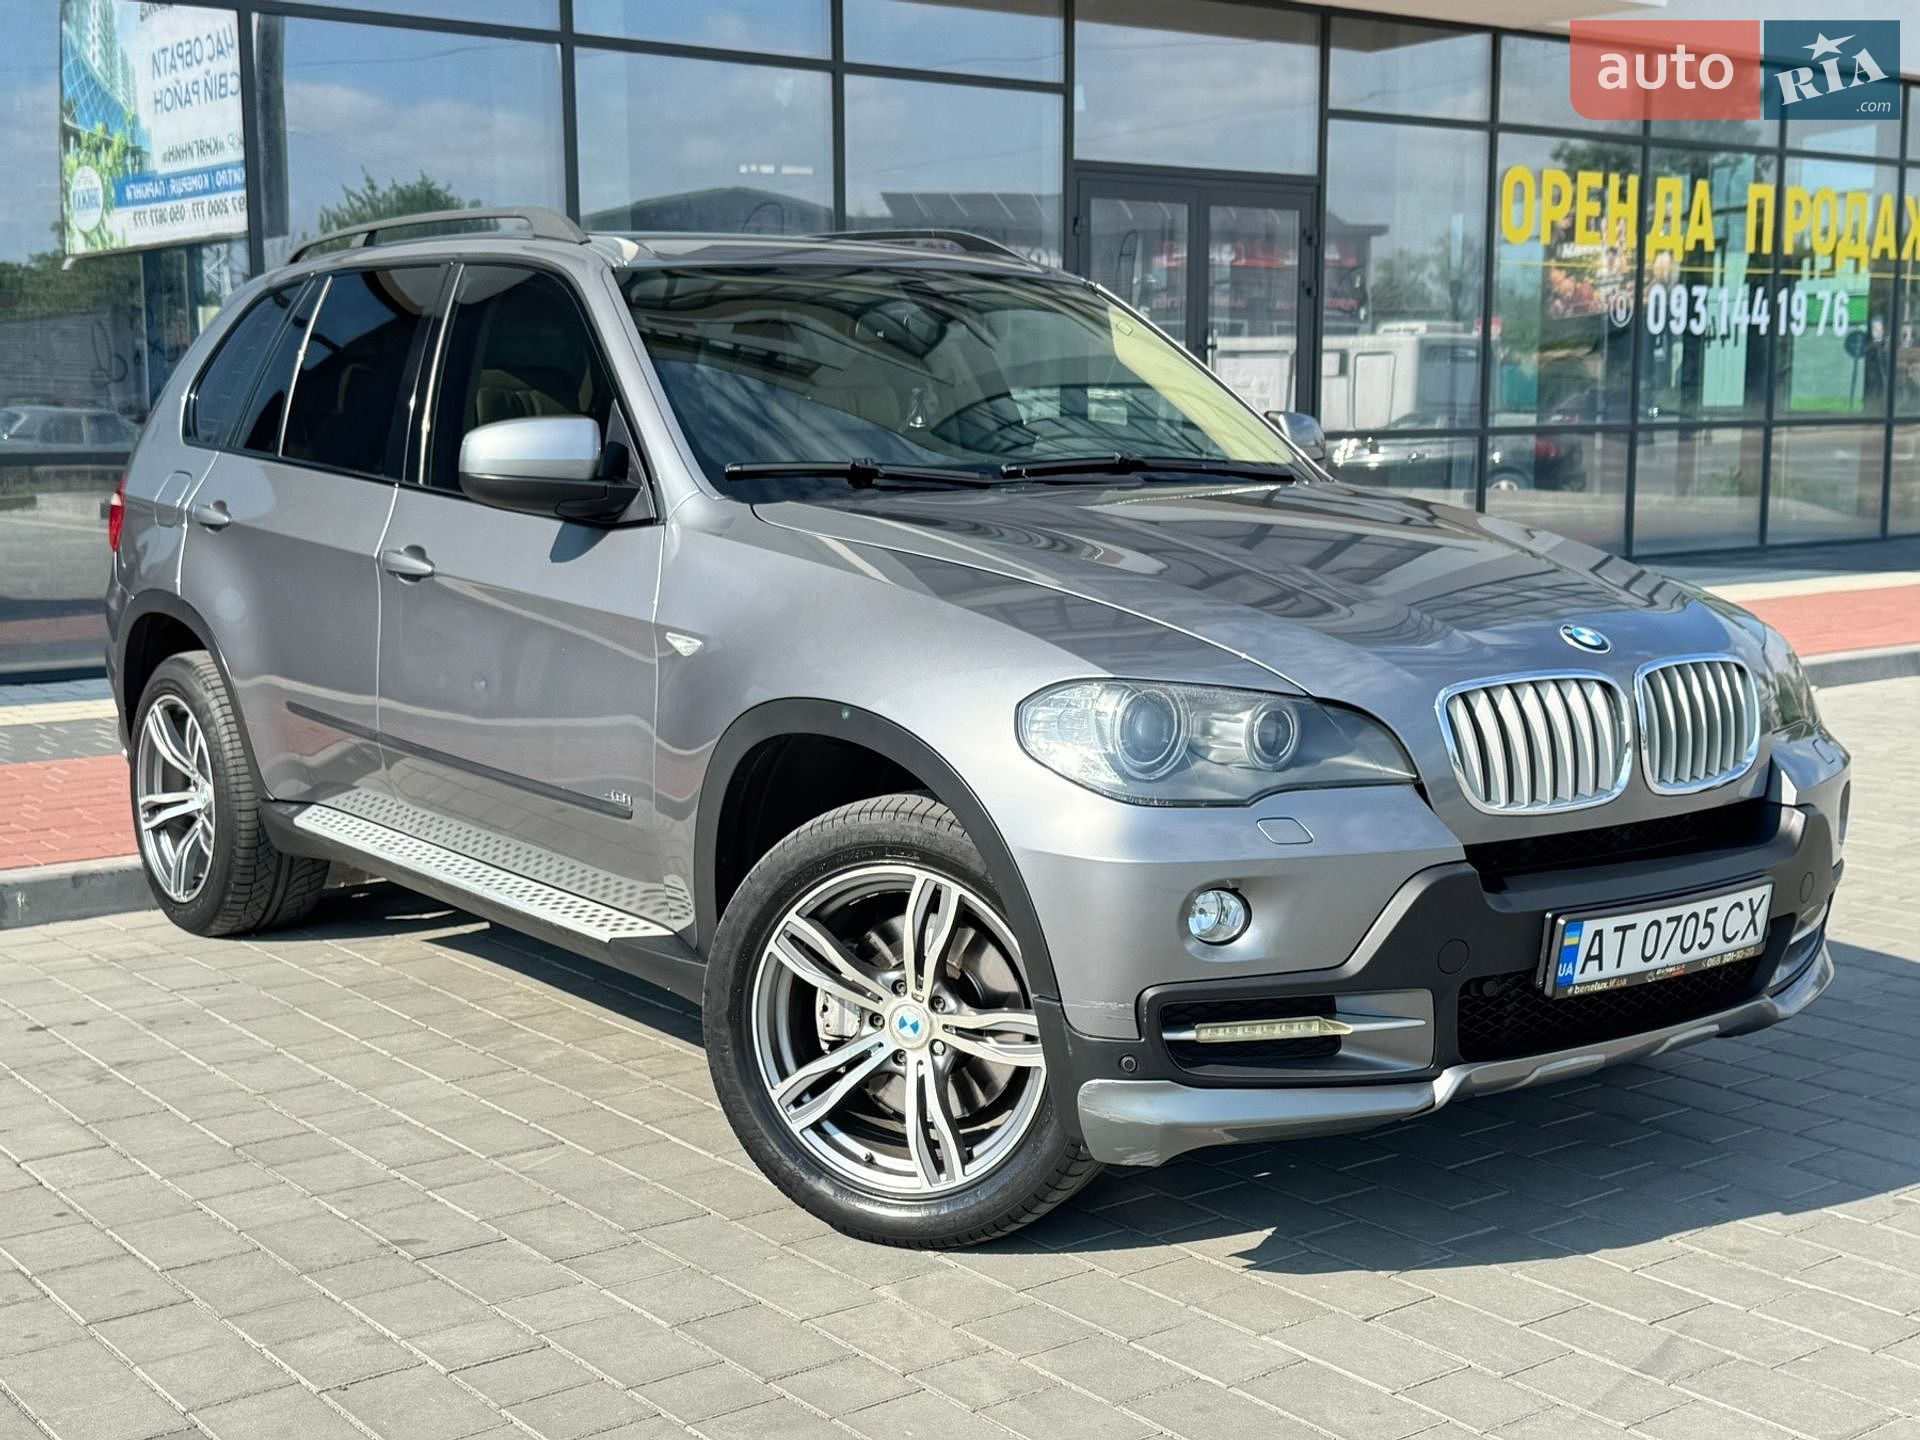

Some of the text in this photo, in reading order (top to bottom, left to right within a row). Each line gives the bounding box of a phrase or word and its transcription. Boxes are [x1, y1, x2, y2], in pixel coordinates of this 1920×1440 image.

[1501, 164, 1716, 263] ОРЕНДА
[1647, 283, 1849, 337] 093 144 19 76
[1579, 895, 1767, 975] AT 0705 CX
[1558, 961, 1574, 977] UA
